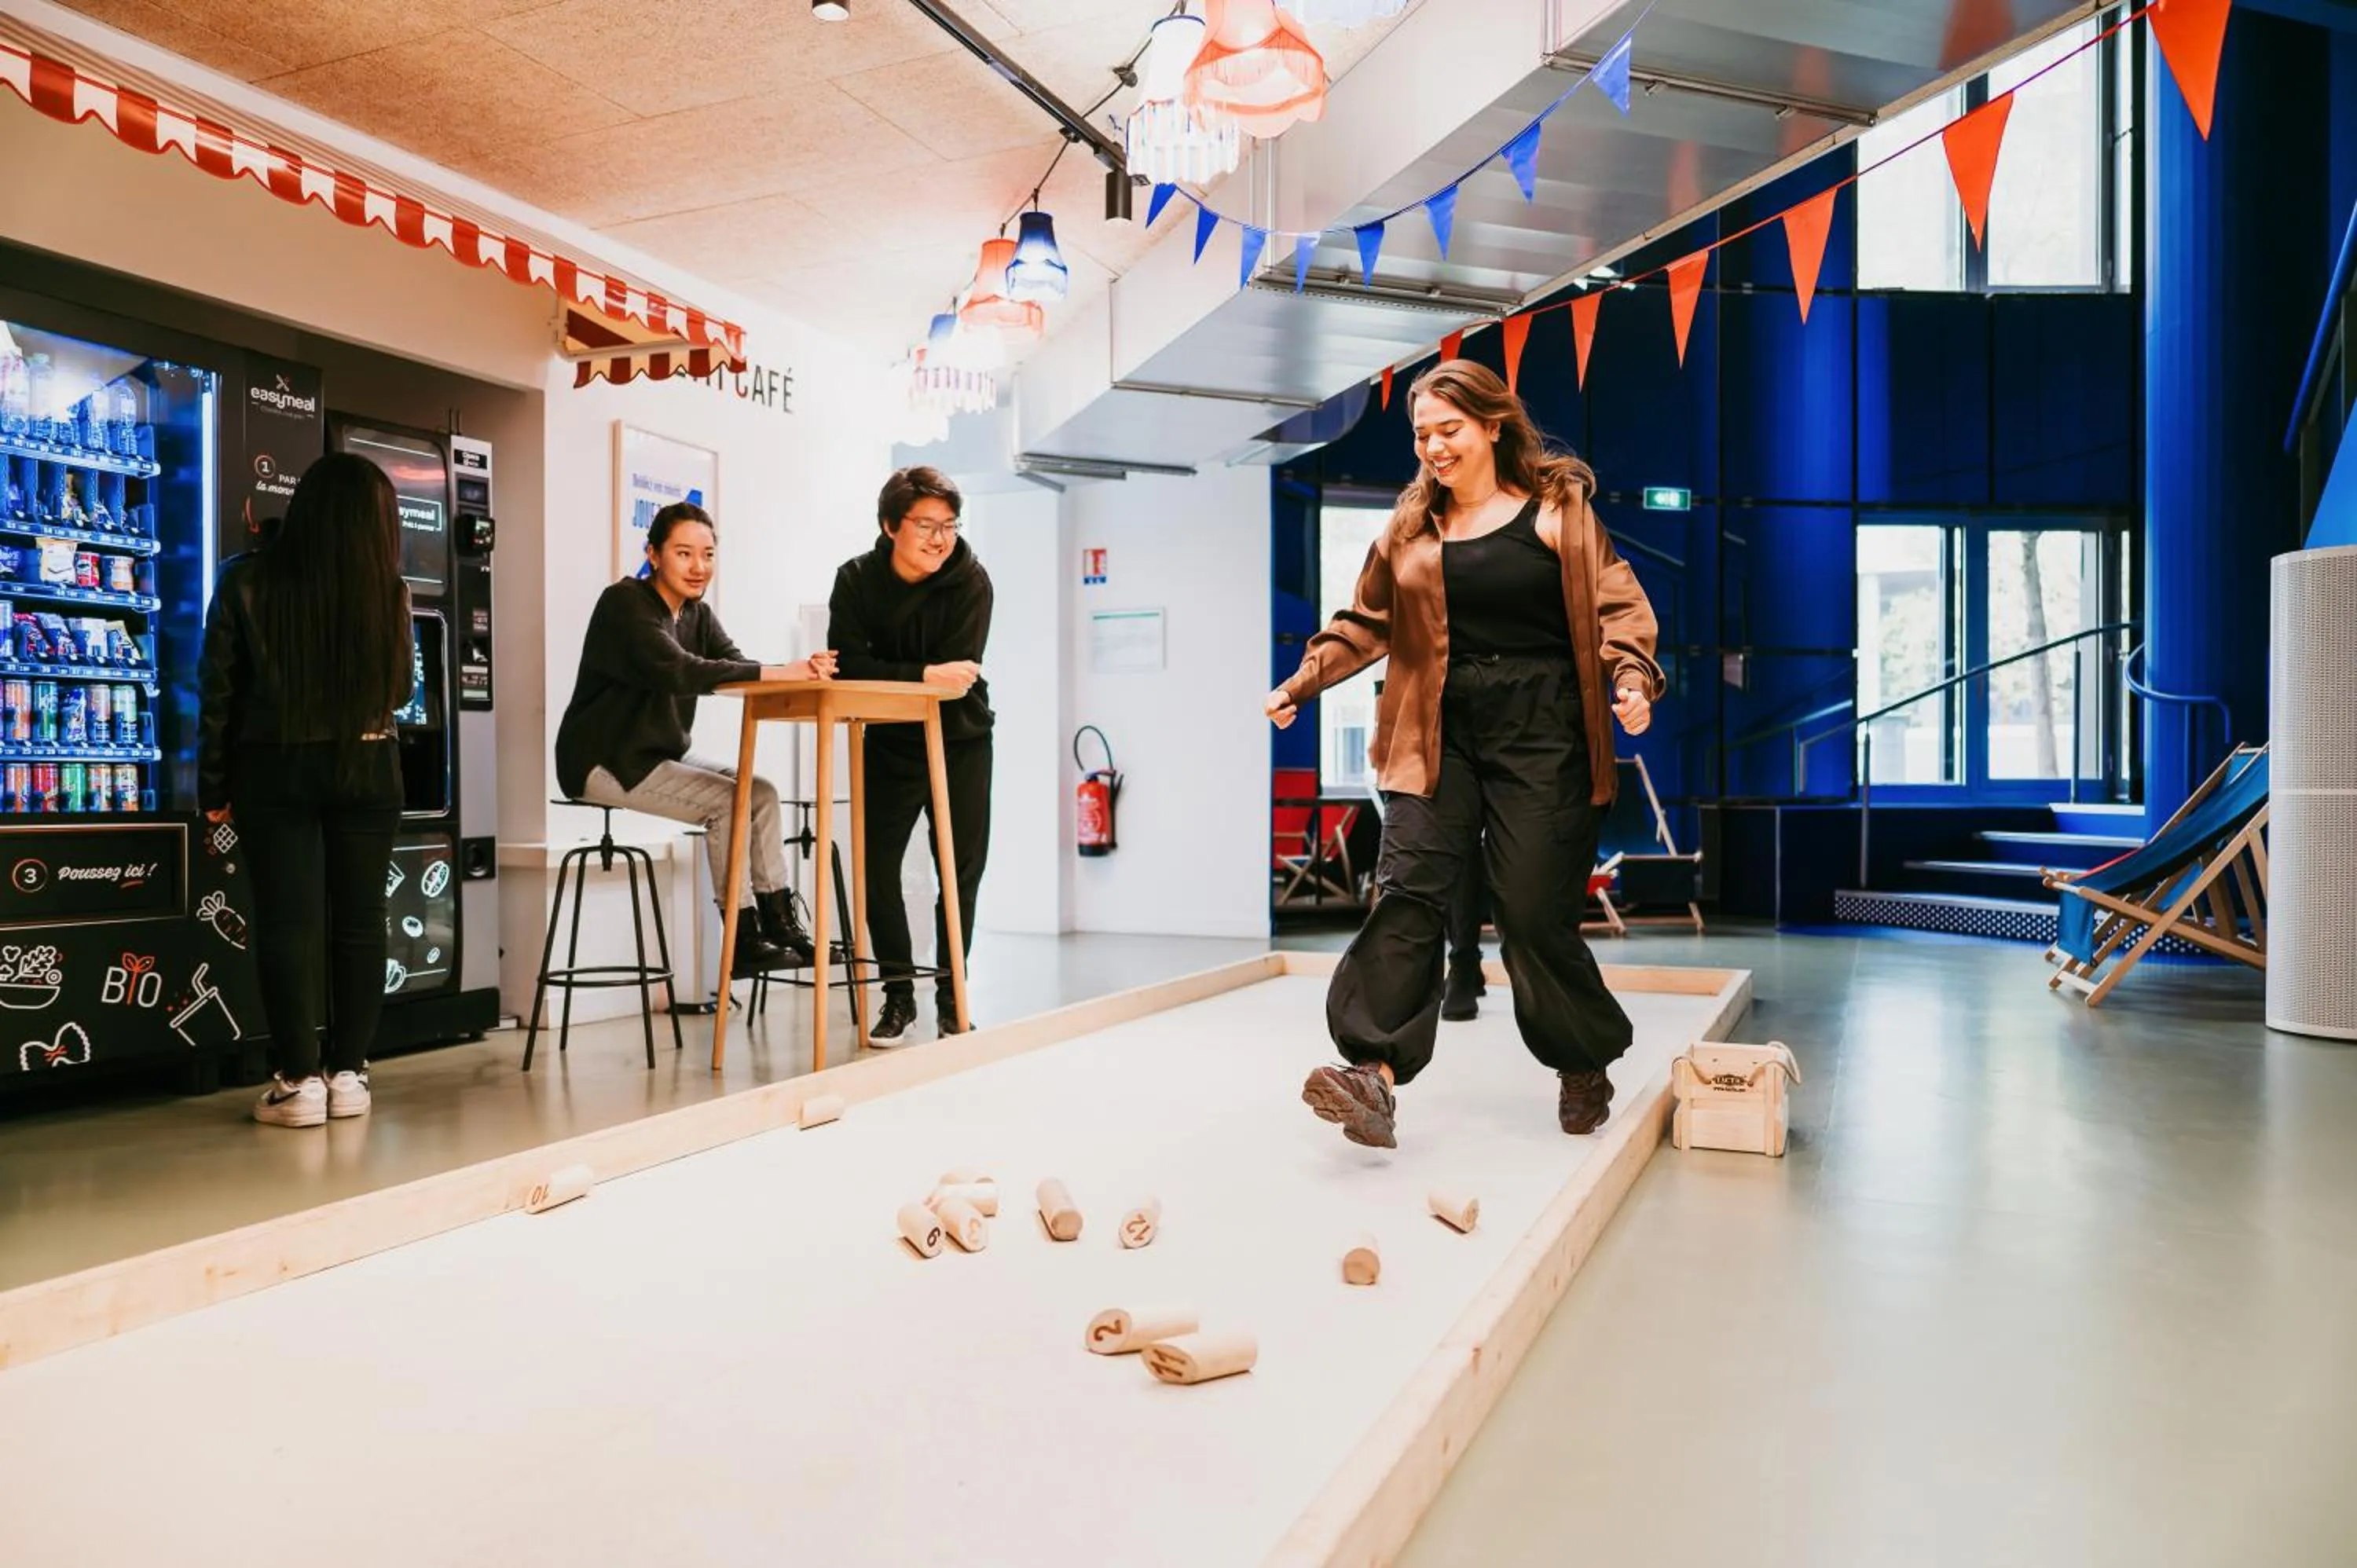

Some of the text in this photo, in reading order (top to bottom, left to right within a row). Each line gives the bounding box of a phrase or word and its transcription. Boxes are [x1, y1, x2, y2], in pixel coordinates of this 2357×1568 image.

[251, 387, 314, 412] easymeal
[261, 461, 269, 472] 1
[24, 868, 37, 884] 3
[57, 866, 121, 881] Poussez
[124, 863, 145, 877] ici
[101, 953, 162, 1007] BIO
[1093, 1319, 1122, 1341] 2
[1149, 1348, 1186, 1377] 11
